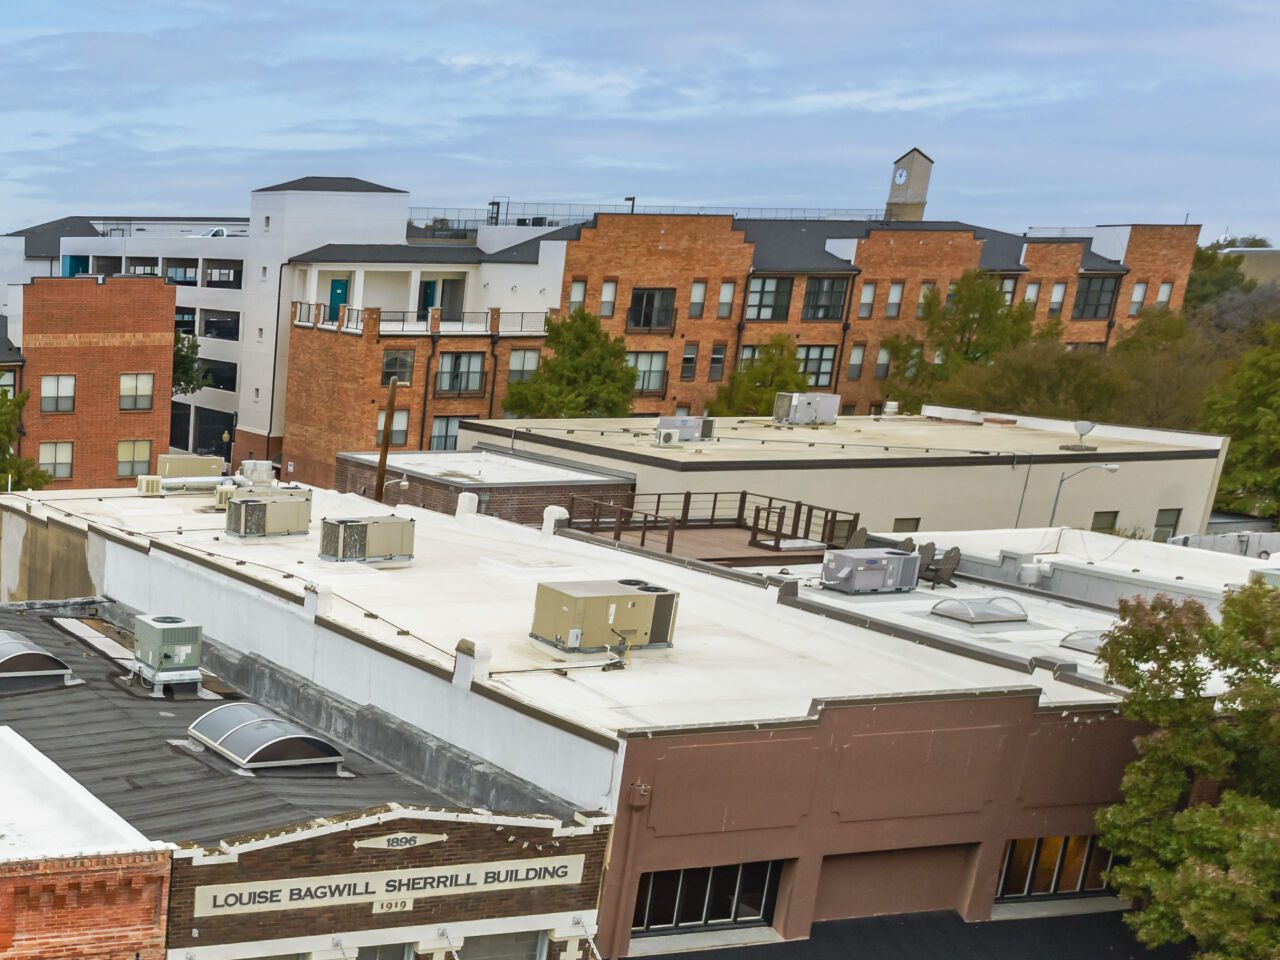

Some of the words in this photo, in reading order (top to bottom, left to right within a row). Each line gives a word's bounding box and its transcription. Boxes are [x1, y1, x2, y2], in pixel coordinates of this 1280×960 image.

[386, 836, 418, 848] 1896
[212, 889, 282, 909] LOUISE
[289, 882, 376, 901] BAGWILL
[385, 873, 477, 893] SHERRILL
[483, 865, 568, 884] BUILDING
[379, 900, 408, 912] 1919
